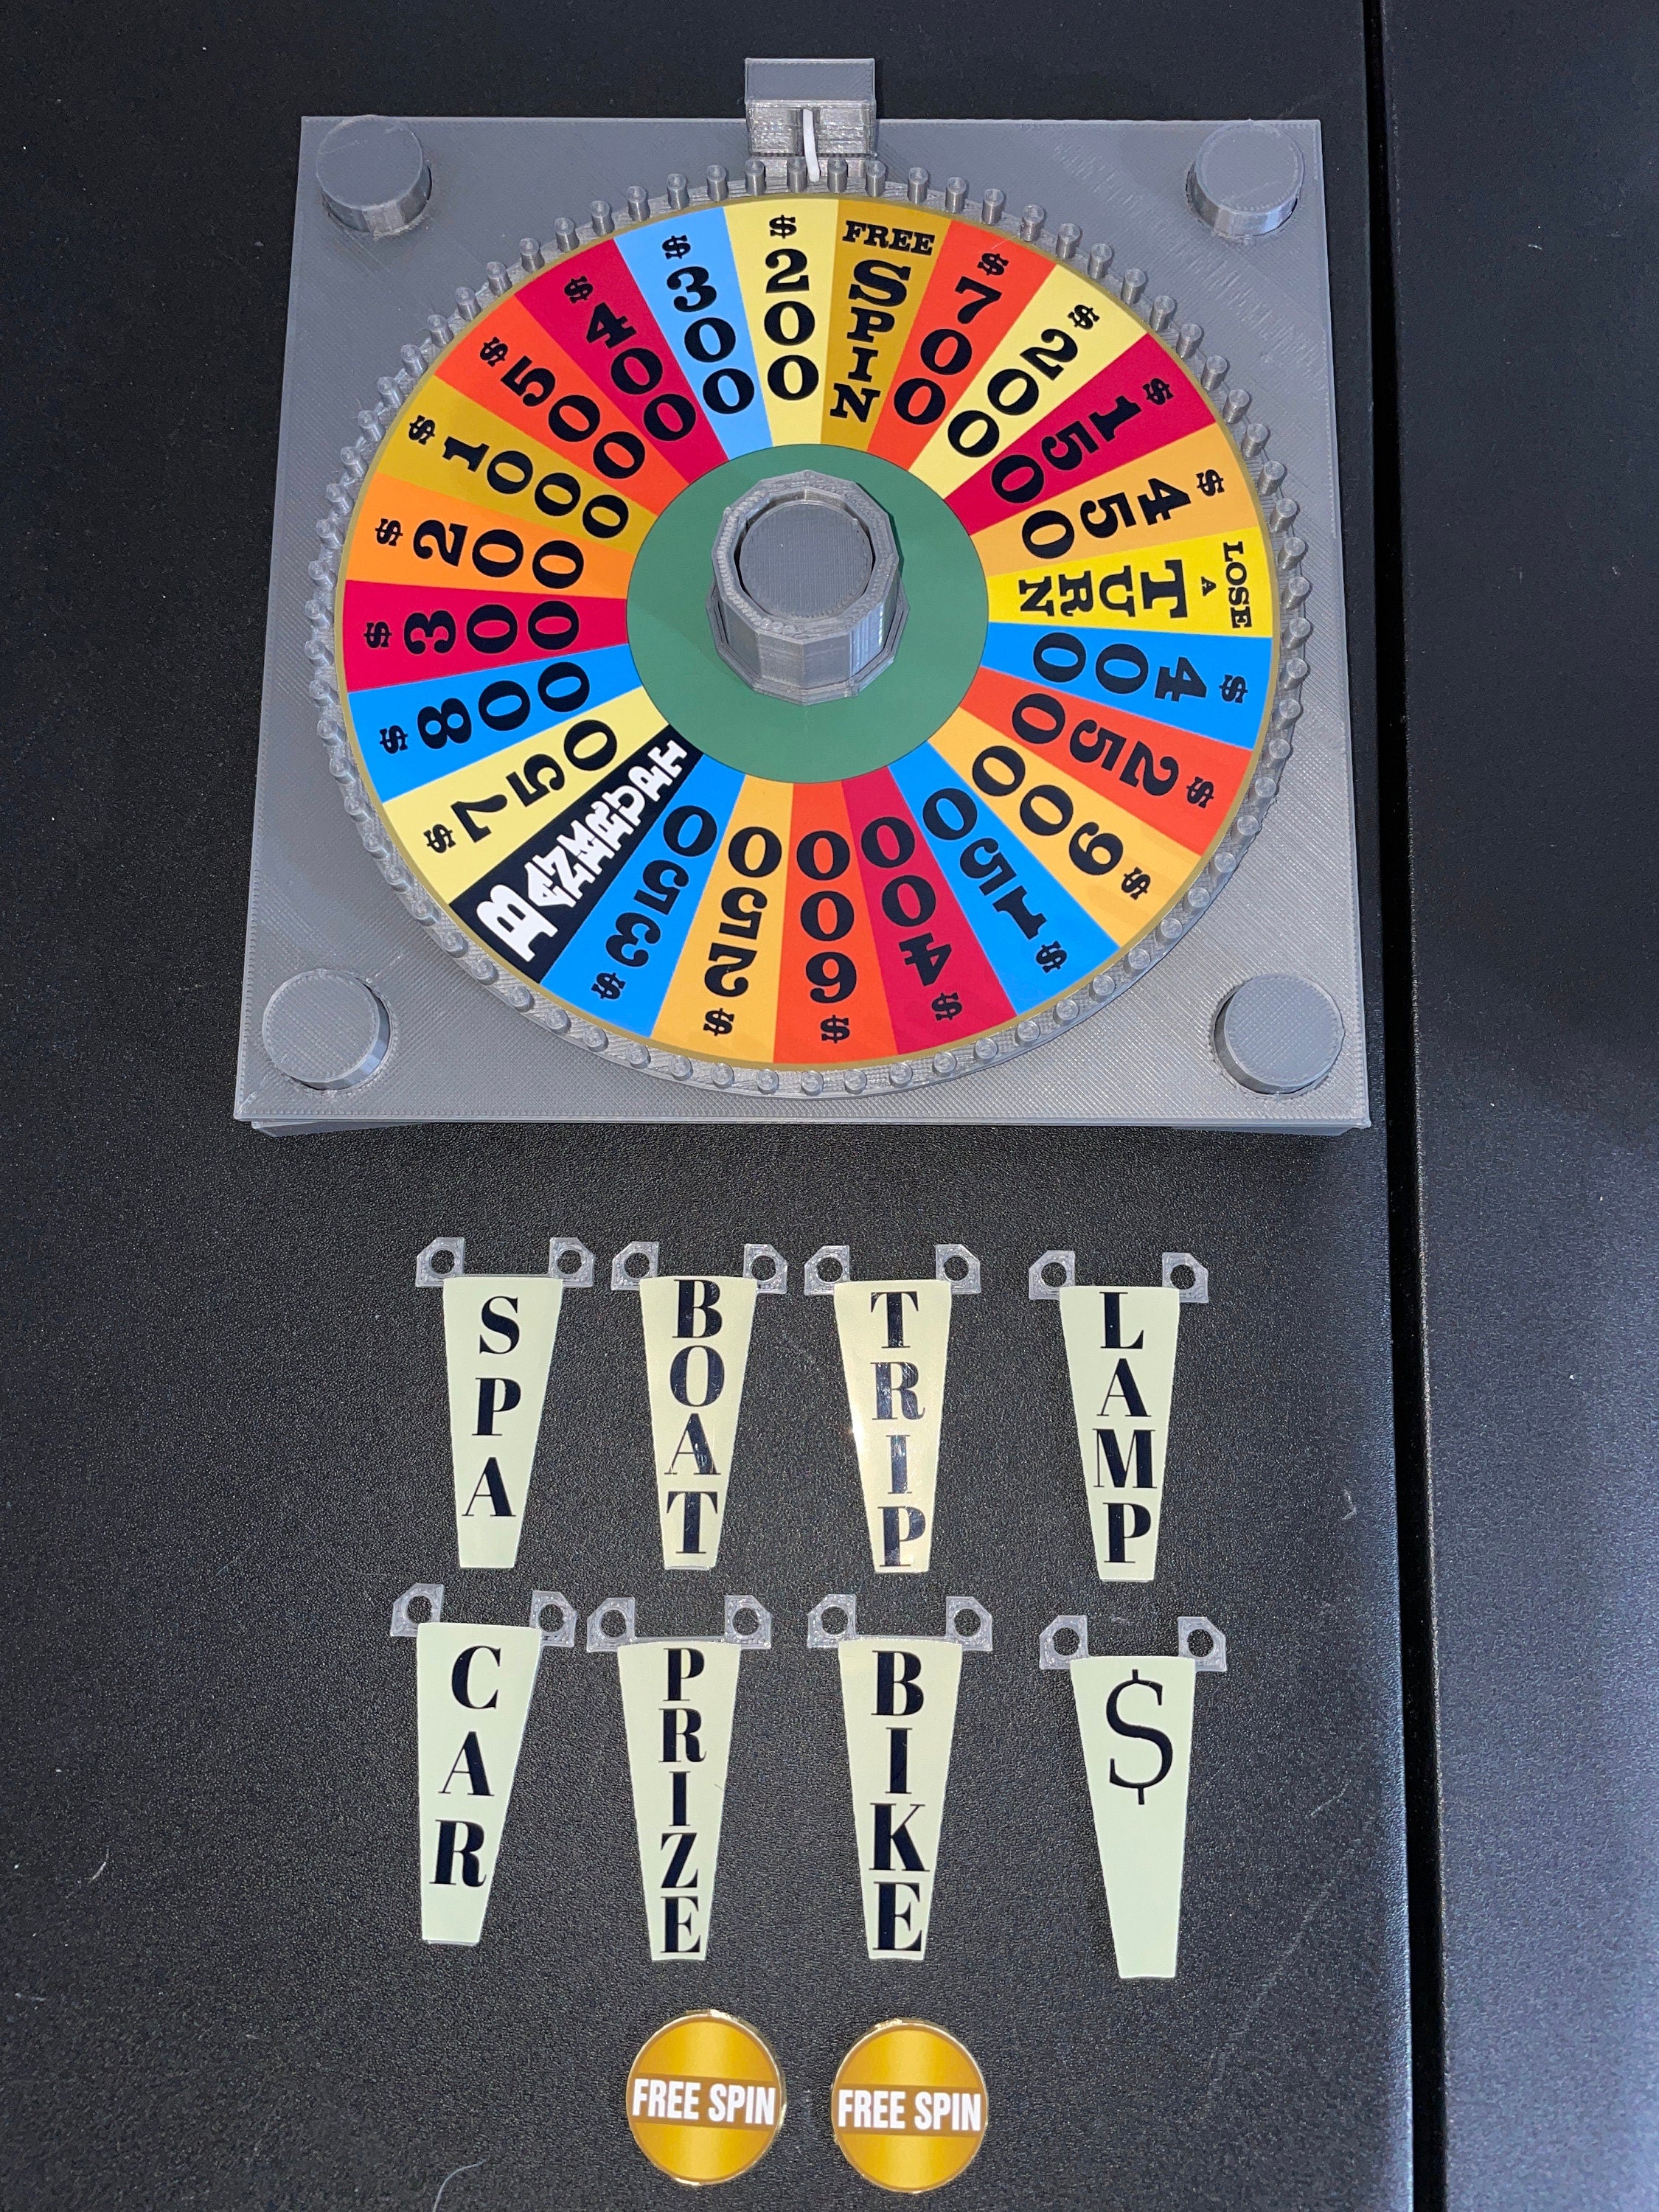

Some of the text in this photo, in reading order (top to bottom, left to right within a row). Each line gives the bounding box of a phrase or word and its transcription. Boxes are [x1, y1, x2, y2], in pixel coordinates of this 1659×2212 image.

[842, 220, 936, 256] FREE
[830, 259, 911, 423] SPIN
[1018, 559, 1188, 619] TURN
[1201, 577, 1217, 597] A
[1223, 541, 1252, 628] LOSE
[475, 739, 689, 963] BANKRUPT
[462, 1295, 521, 1517] SPA
[663, 1279, 725, 1554] BOAT
[869, 1290, 927, 1568] TRIP
[1092, 1291, 1158, 1563] LAMP
[429, 1645, 501, 1888] CAR
[657, 1646, 708, 1955] PRIZE
[869, 1650, 930, 1952] BIKE
[1106, 1669, 1173, 1806] $
[631, 2077, 777, 2126] FREE SPIN
[837, 2087, 982, 2132] FREE SPIN
